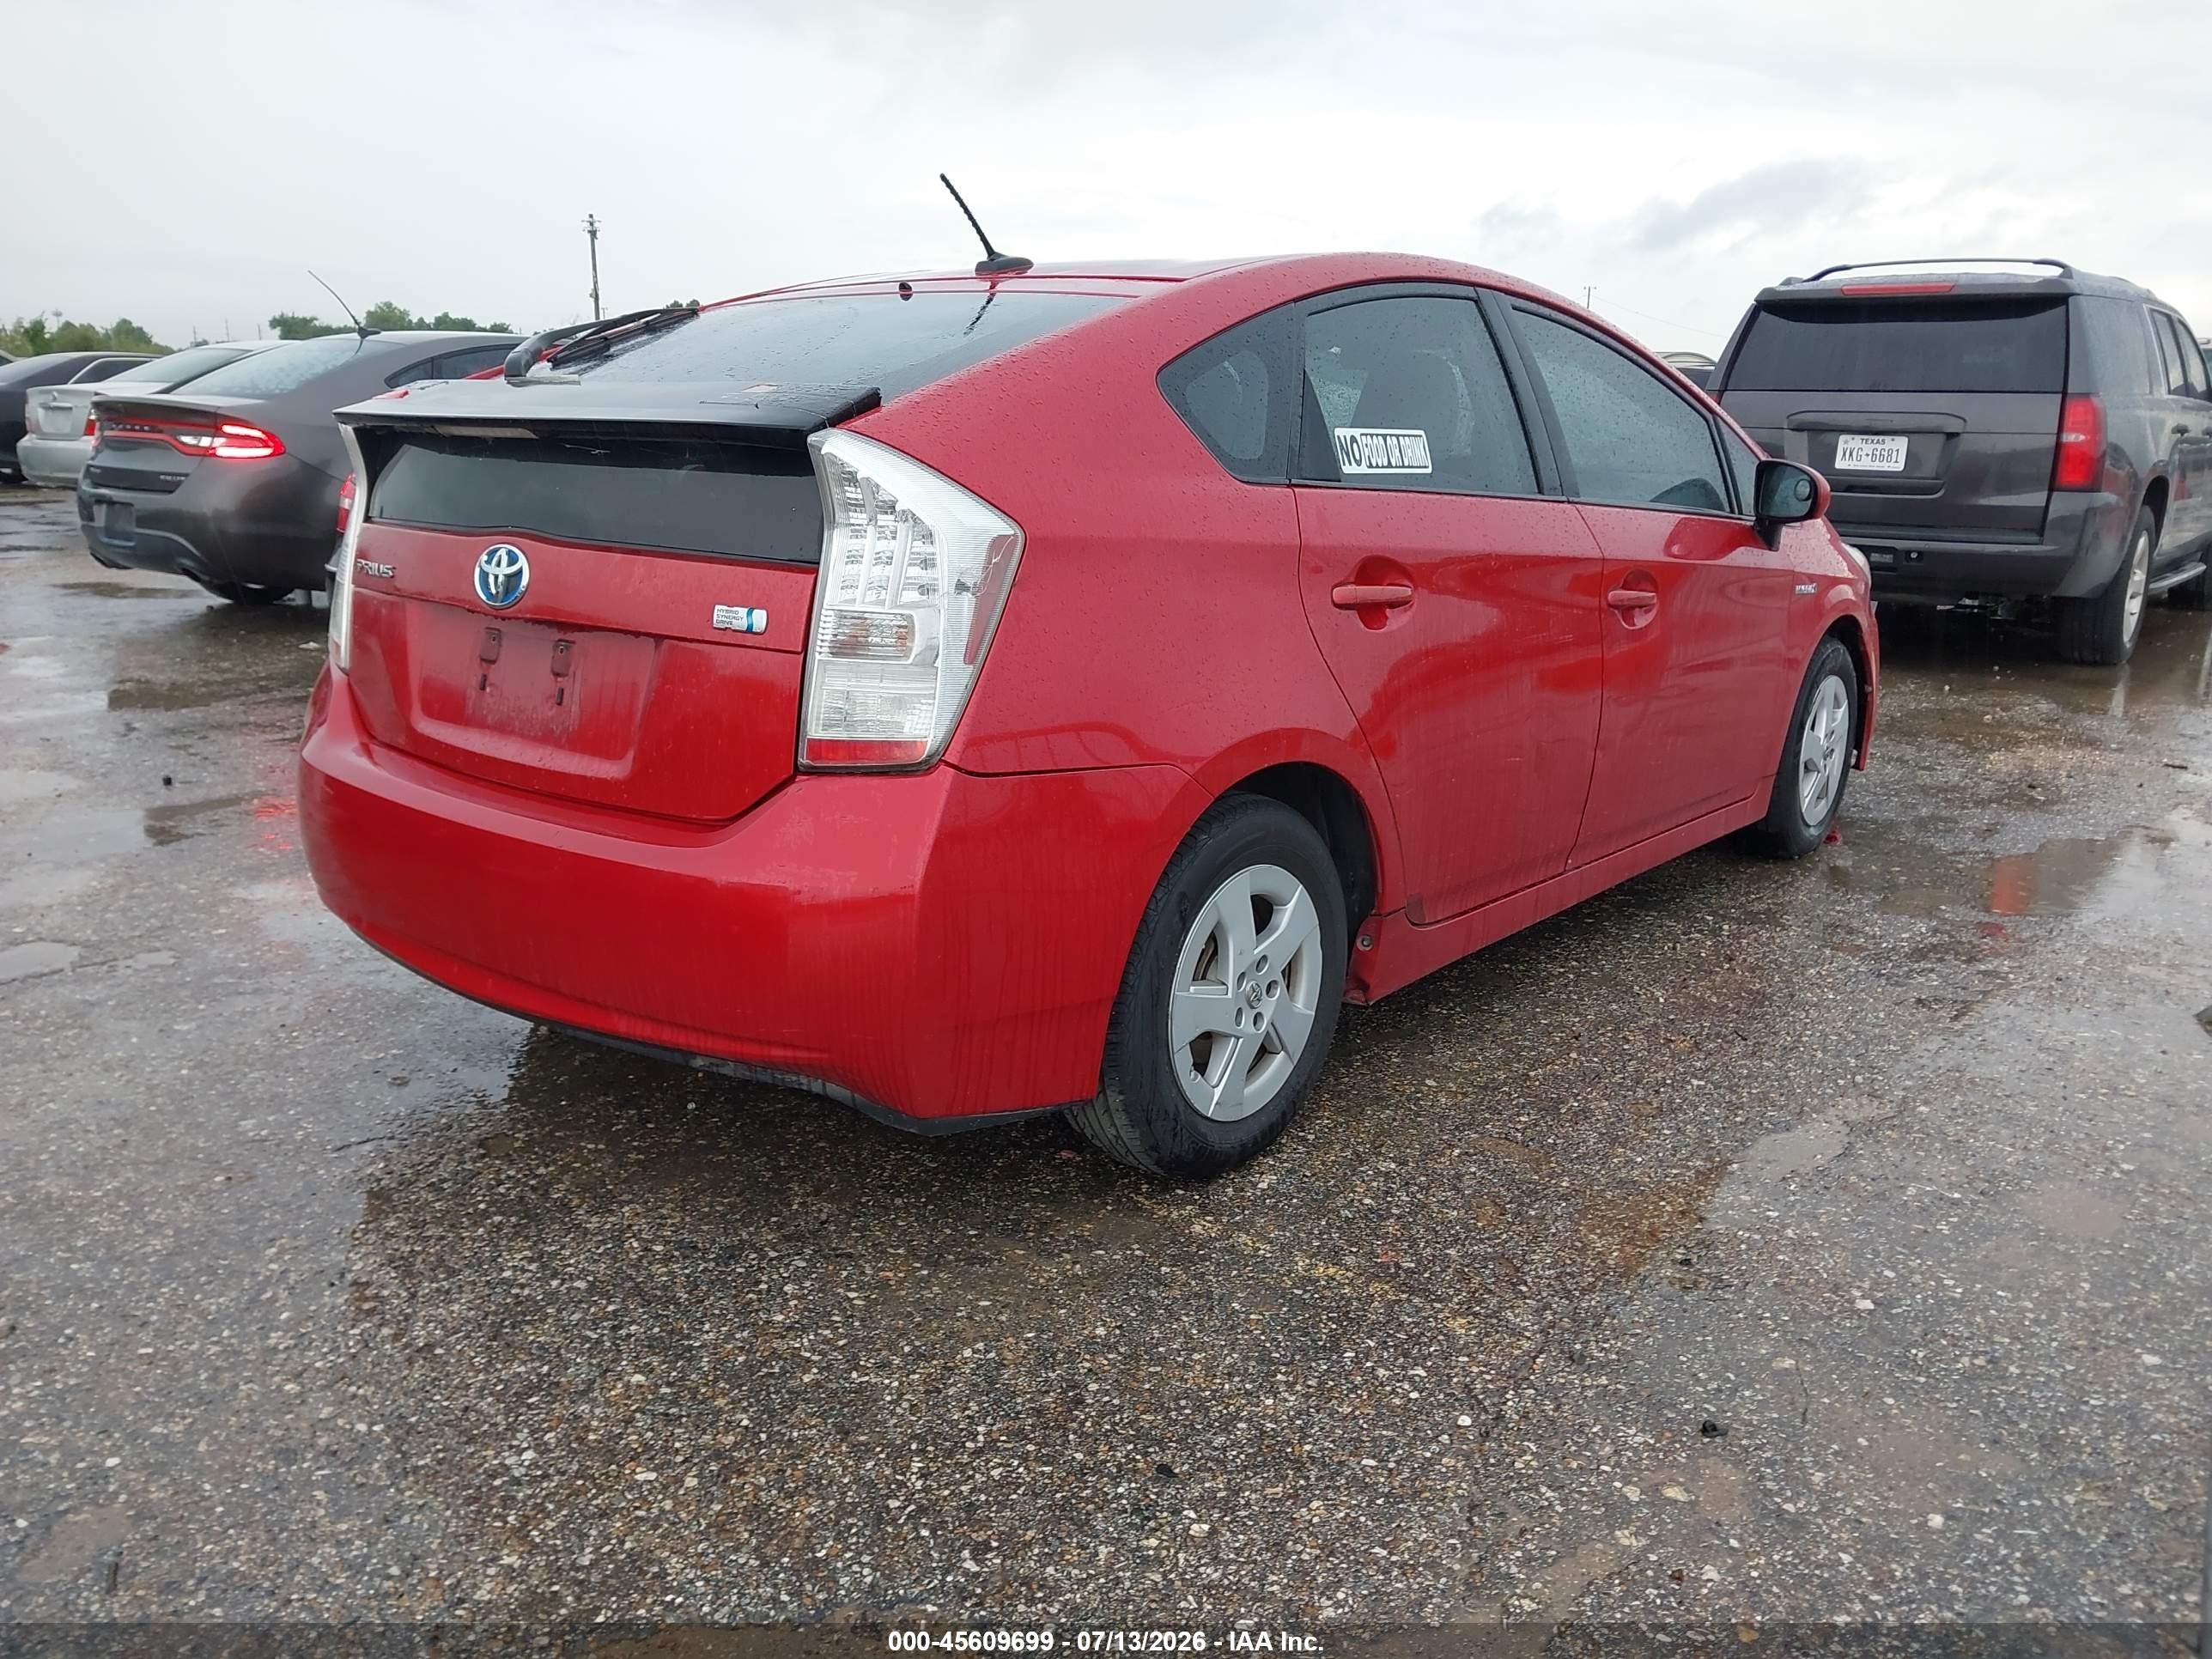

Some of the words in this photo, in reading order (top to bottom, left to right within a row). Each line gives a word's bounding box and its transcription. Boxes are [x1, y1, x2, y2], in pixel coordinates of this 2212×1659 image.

[1337, 434, 1362, 466] NO
[1361, 435, 1389, 467] FOOD
[1386, 435, 1403, 467] OR
[1400, 436, 1429, 467] DRINK
[356, 559, 396, 577] PRIUS
[716, 613, 744, 622] SYNERGY
